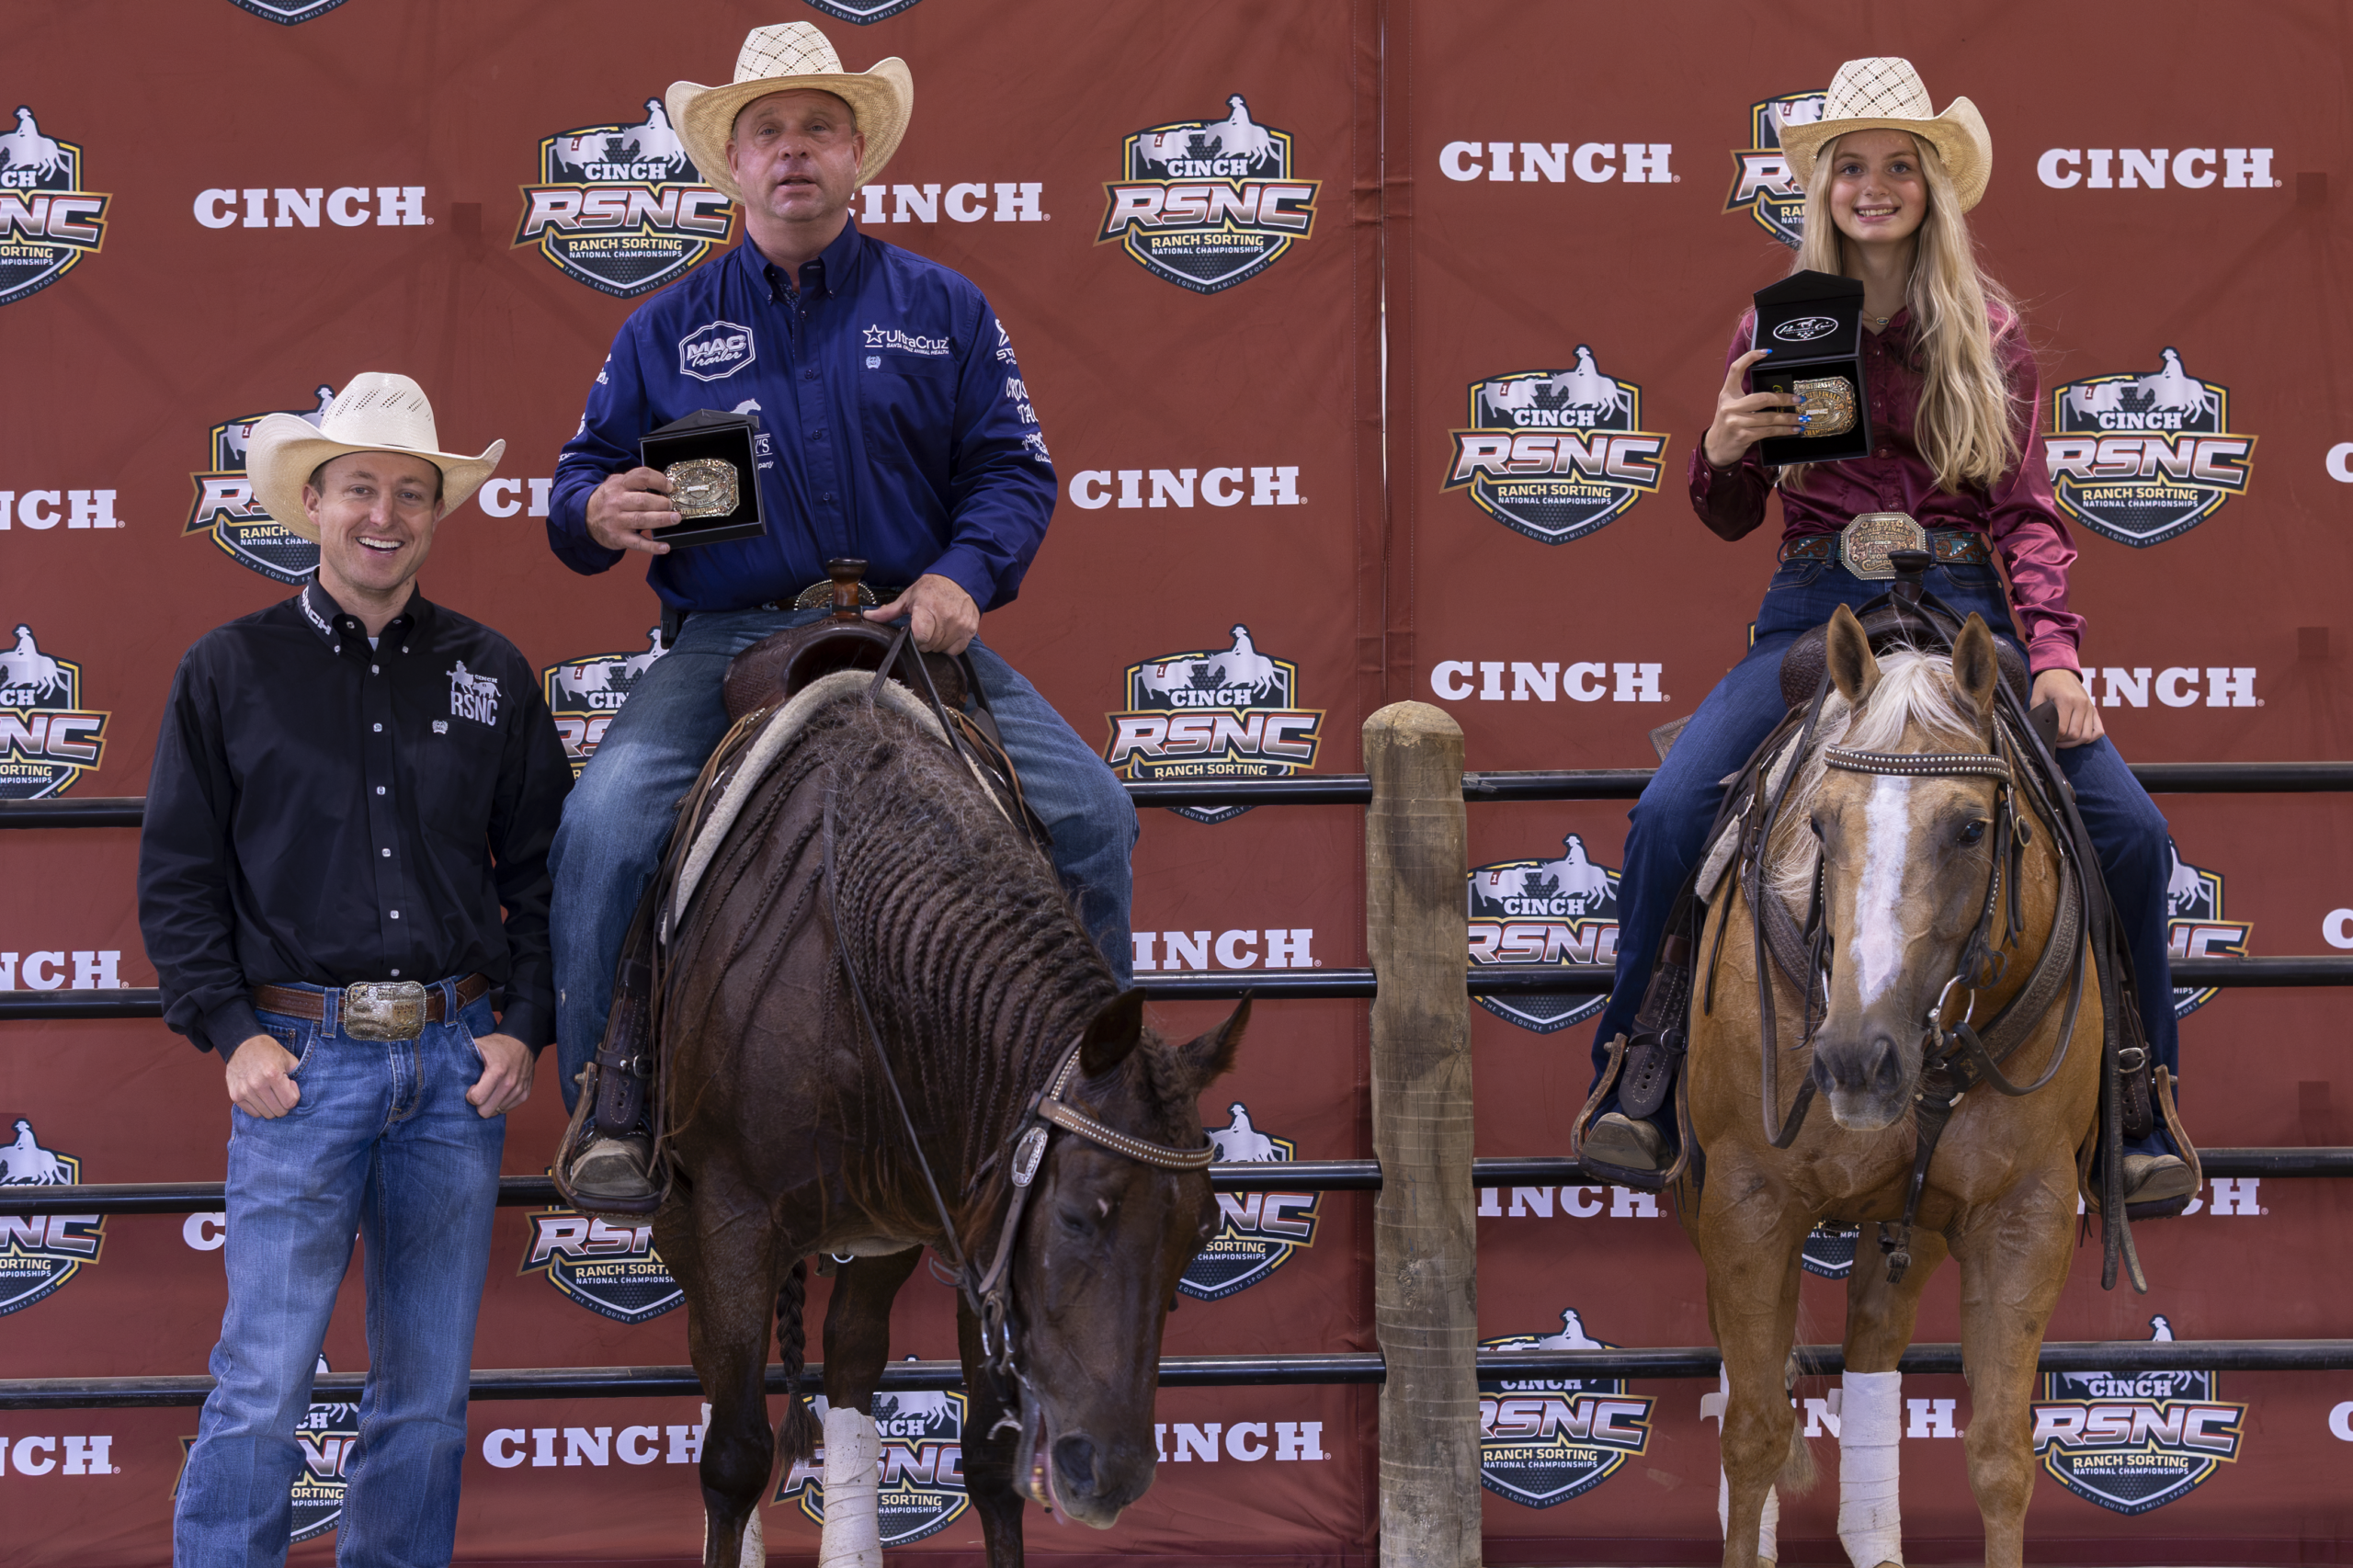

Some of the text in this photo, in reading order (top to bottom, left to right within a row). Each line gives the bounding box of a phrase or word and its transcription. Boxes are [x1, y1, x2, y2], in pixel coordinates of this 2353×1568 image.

[257, 7, 324, 24] EQUINE FAMILY
[831, 6, 897, 24] EQUINE FAMILY
[572, 140, 579, 149] 1
[1154, 137, 1162, 146] 1
[585, 163, 666, 180] CINCH
[1167, 159, 1248, 176] CINCH
[1439, 142, 1672, 184] CINCH
[2037, 147, 2274, 189] CINCH
[193, 186, 426, 229] CINCH
[848, 183, 1043, 223] INCH
[1106, 184, 1313, 233] RSNC
[0, 196, 102, 243] NC
[523, 188, 732, 236] RSNC
[569, 238, 683, 252] RANCH SORTING
[1152, 233, 1264, 248] RANCH SORTING
[0, 245, 53, 258] ORTING
[569, 250, 683, 259] NATIONAL CHAMPIONSHIPS
[1152, 245, 1264, 256] NATIONAL CHAMPIONSHIPS
[563, 265, 688, 297] THE EQUINE FAMILY SPORT
[1146, 261, 1268, 293] THE EQUINE FAMILY SPORT
[0, 273, 58, 303] FAMILY SPORT
[687, 334, 746, 359] MAC
[886, 330, 949, 349] UltraCruz
[690, 349, 743, 368] Trailer
[1501, 385, 1507, 394] 1
[2086, 388, 2093, 398] 1
[1513, 409, 1596, 426] CINCH
[2098, 412, 2182, 429] CINCH
[243, 427, 250, 437] 1
[1452, 435, 1660, 483] RSNC
[2044, 437, 2248, 484] RSNC
[1069, 466, 1300, 510] CINCH
[1498, 484, 1611, 498] RANCH SORTING
[2083, 487, 2199, 501] RANCH SORTING
[1542, 496, 1612, 506] CHAMPIONSHIPS
[240, 526, 290, 539] RANCH
[1493, 511, 1616, 543] THE EQUINE FAMILY SPORT
[2076, 515, 2203, 546] THE EQUINE FAMILY SPORT
[240, 538, 283, 546] NATIONAL
[234, 553, 296, 584] THE EQUINE
[301, 585, 332, 635] CINCH
[474, 674, 498, 684] CINCH
[575, 668, 582, 677] 1
[1157, 666, 1165, 676] 1
[1431, 660, 1663, 702] CINCH
[2083, 667, 2256, 708] NCH
[587, 691, 629, 709] CIN
[1170, 688, 1252, 707] CINCH
[450, 690, 498, 726] RSNC
[0, 714, 101, 762] NC
[1108, 714, 1316, 763] RSNC
[0, 764, 52, 777] ORTING
[1154, 764, 1267, 778] RANCH SORTING
[1178, 809, 1210, 823] EQUINE
[1491, 874, 1498, 883] 1
[1504, 898, 1586, 915] CINCH
[1132, 929, 1313, 971] INCH
[1482, 1000, 1606, 1032] THE EQUINE FAMILY SPORT
[1477, 1187, 1659, 1218] INCH
[1213, 1191, 1314, 1239] NC
[0, 1215, 101, 1256] NC
[1205, 1241, 1267, 1253] SORTING
[0, 1258, 51, 1270] ORTING
[1197, 1253, 1267, 1261] CHAMPIONSHIPS
[0, 1270, 51, 1278] MPIONSHIPS
[575, 1264, 669, 1278] RANCH SORT
[575, 1277, 619, 1285] NATIONAL
[1177, 1267, 1271, 1299] EQUINE FAMILY SPORT
[30, 1285, 56, 1302] SPORT
[570, 1292, 686, 1322] THE EQUINE FAMILY SPO
[1499, 1379, 1582, 1390] CINCH
[2088, 1380, 2172, 1396] CINCH
[875, 1419, 926, 1437] NCH
[2031, 1405, 2238, 1452] RSNC
[483, 1426, 704, 1468] CINCH
[1154, 1421, 1324, 1461] NCH
[1483, 1449, 1597, 1461] RANCH SORTING
[2073, 1455, 2189, 1468] RANCH SORTING
[1483, 1460, 1526, 1469] NATIONAL
[2073, 1467, 2189, 1475] NATIONAL CHAMPIONSHIPS
[290, 1487, 345, 1499] ORTING
[881, 1494, 942, 1506] SORTING
[1507, 1476, 1602, 1507] EQUINE FAMILY SPORT
[2067, 1483, 2194, 1514] THE EQUINE FAMILY SPORT
[290, 1499, 344, 1507] MPIONSHIPS
[879, 1506, 943, 1514] HAMPIONSHIPS
[323, 1518, 340, 1531] SPO
[922, 1520, 948, 1539] SPORT
